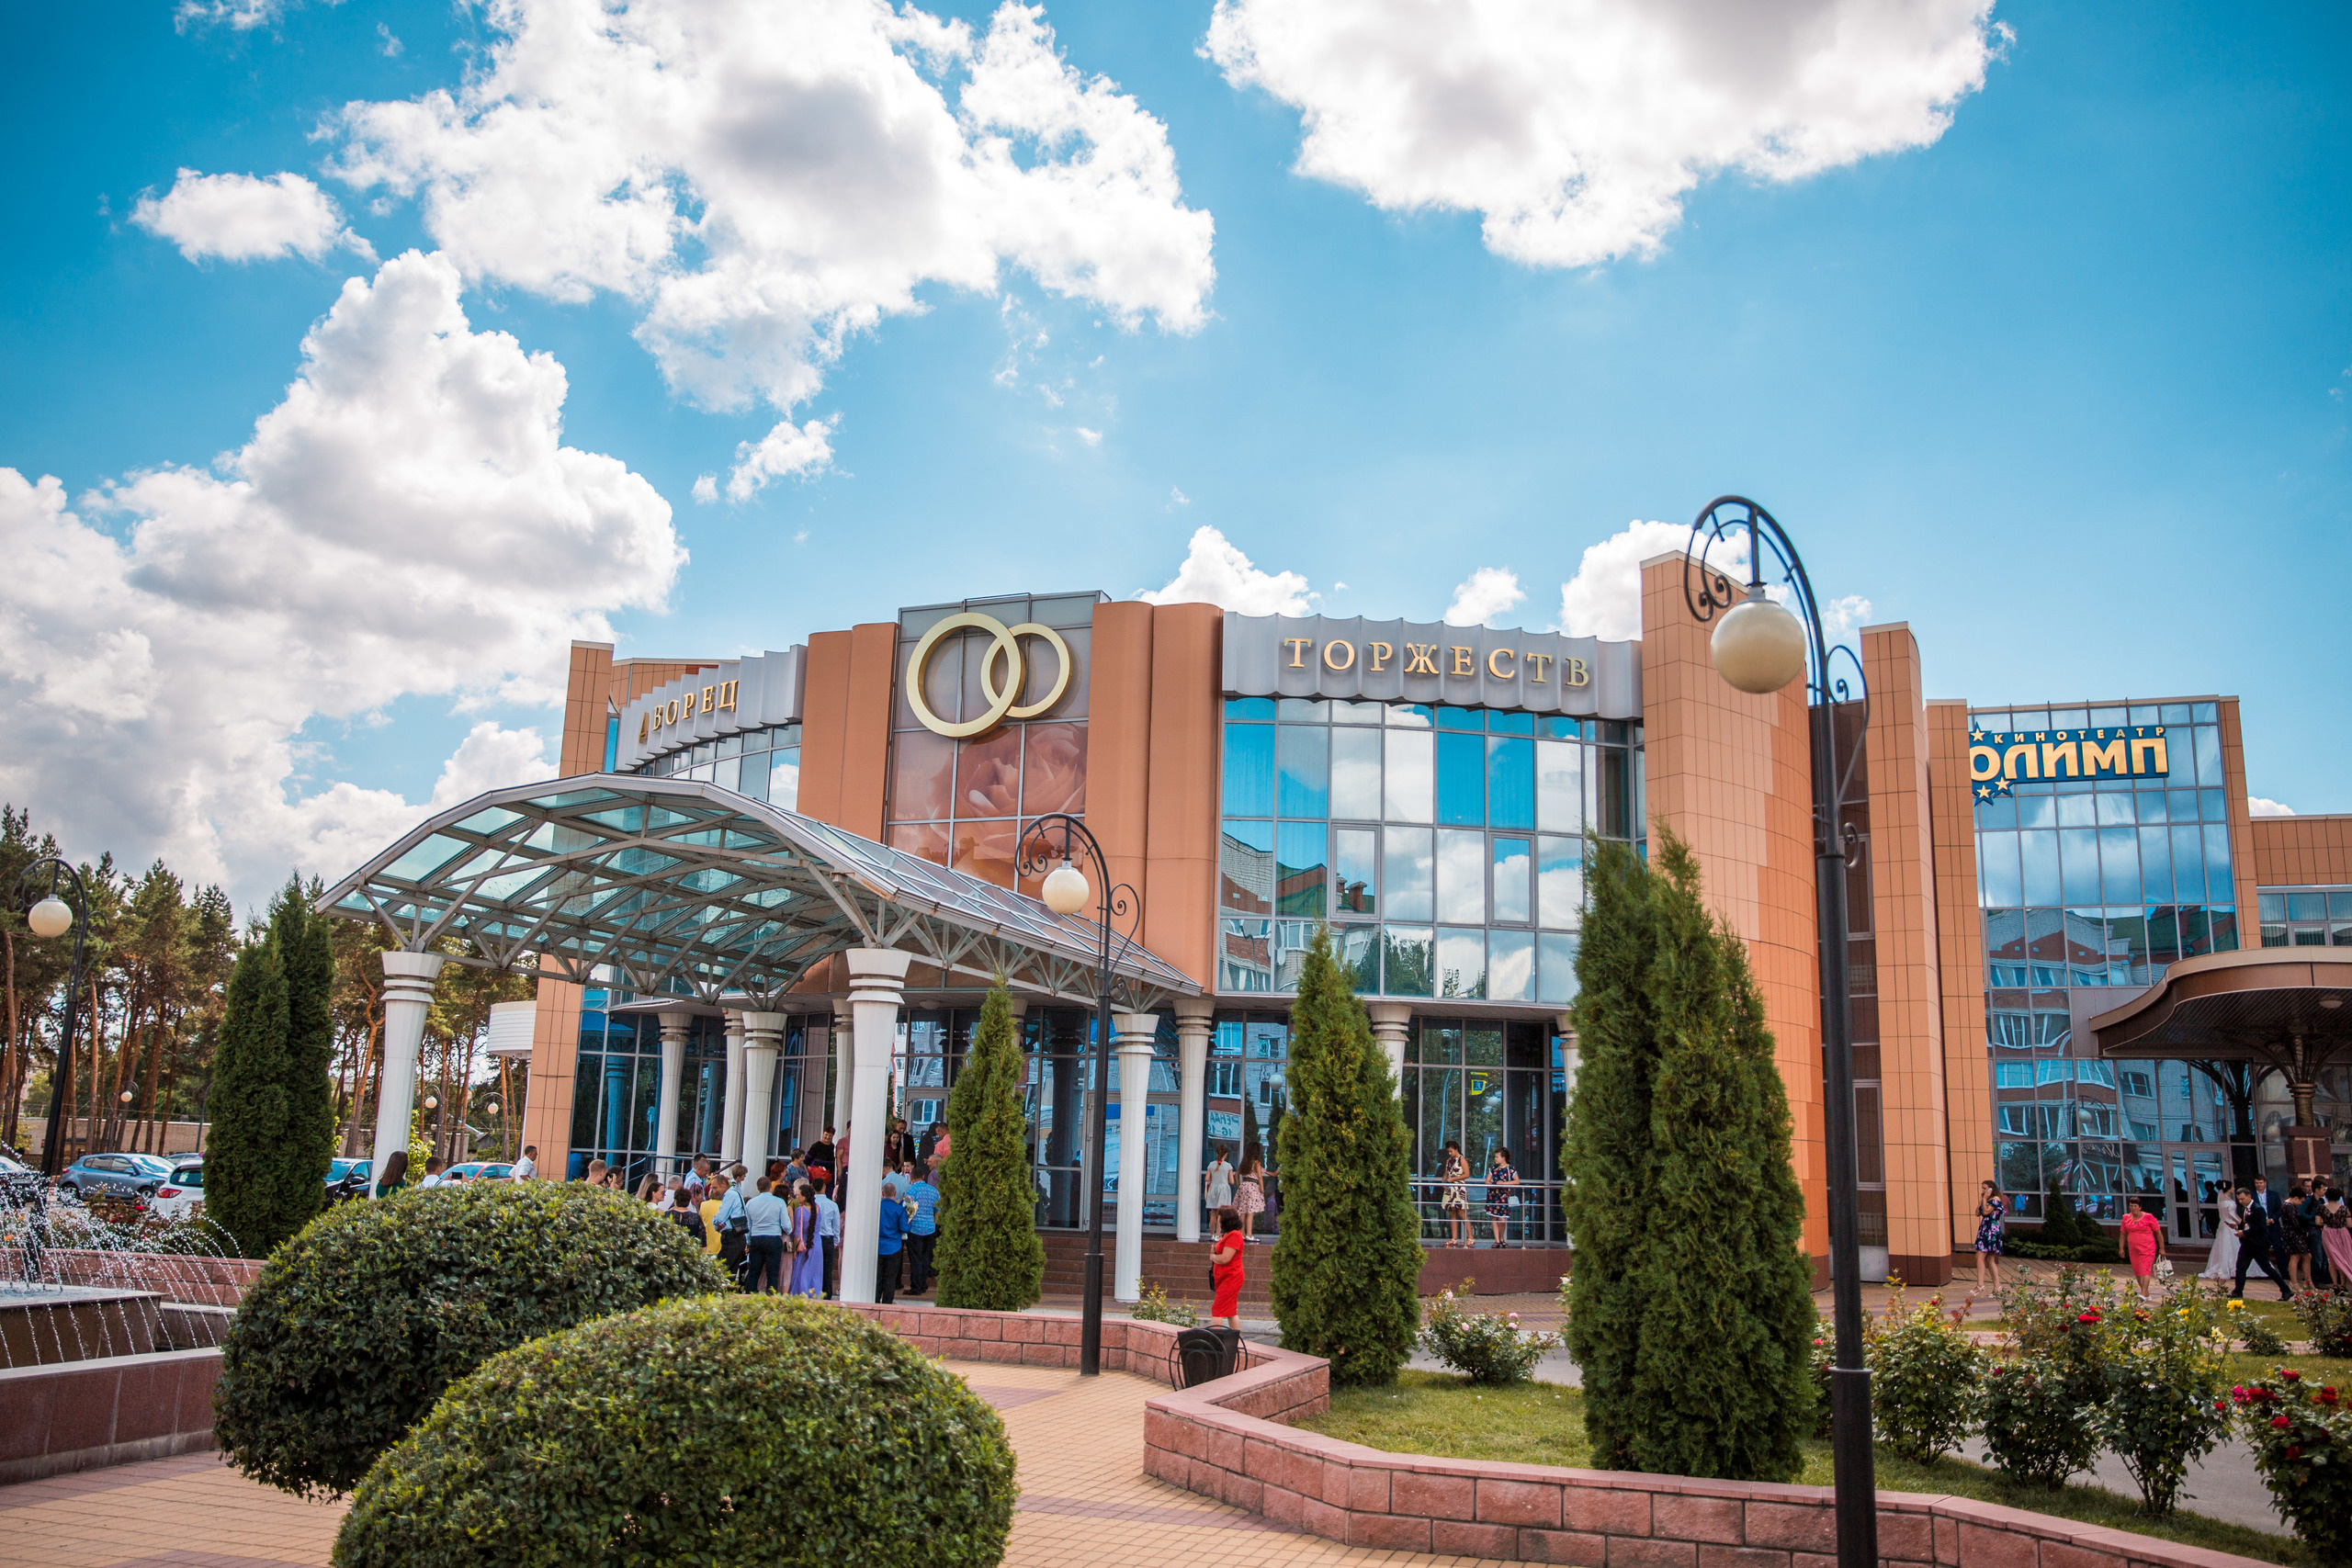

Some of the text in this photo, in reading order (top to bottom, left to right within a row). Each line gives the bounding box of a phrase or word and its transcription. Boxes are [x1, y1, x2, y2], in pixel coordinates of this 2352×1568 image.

[1283, 637, 1589, 686] ТОРЖЕСТВ
[639, 680, 739, 743] ДВОРЕЦ
[1994, 727, 2165, 744] КИНОТЕАТР
[1970, 738, 2168, 782] ОЛИМП
